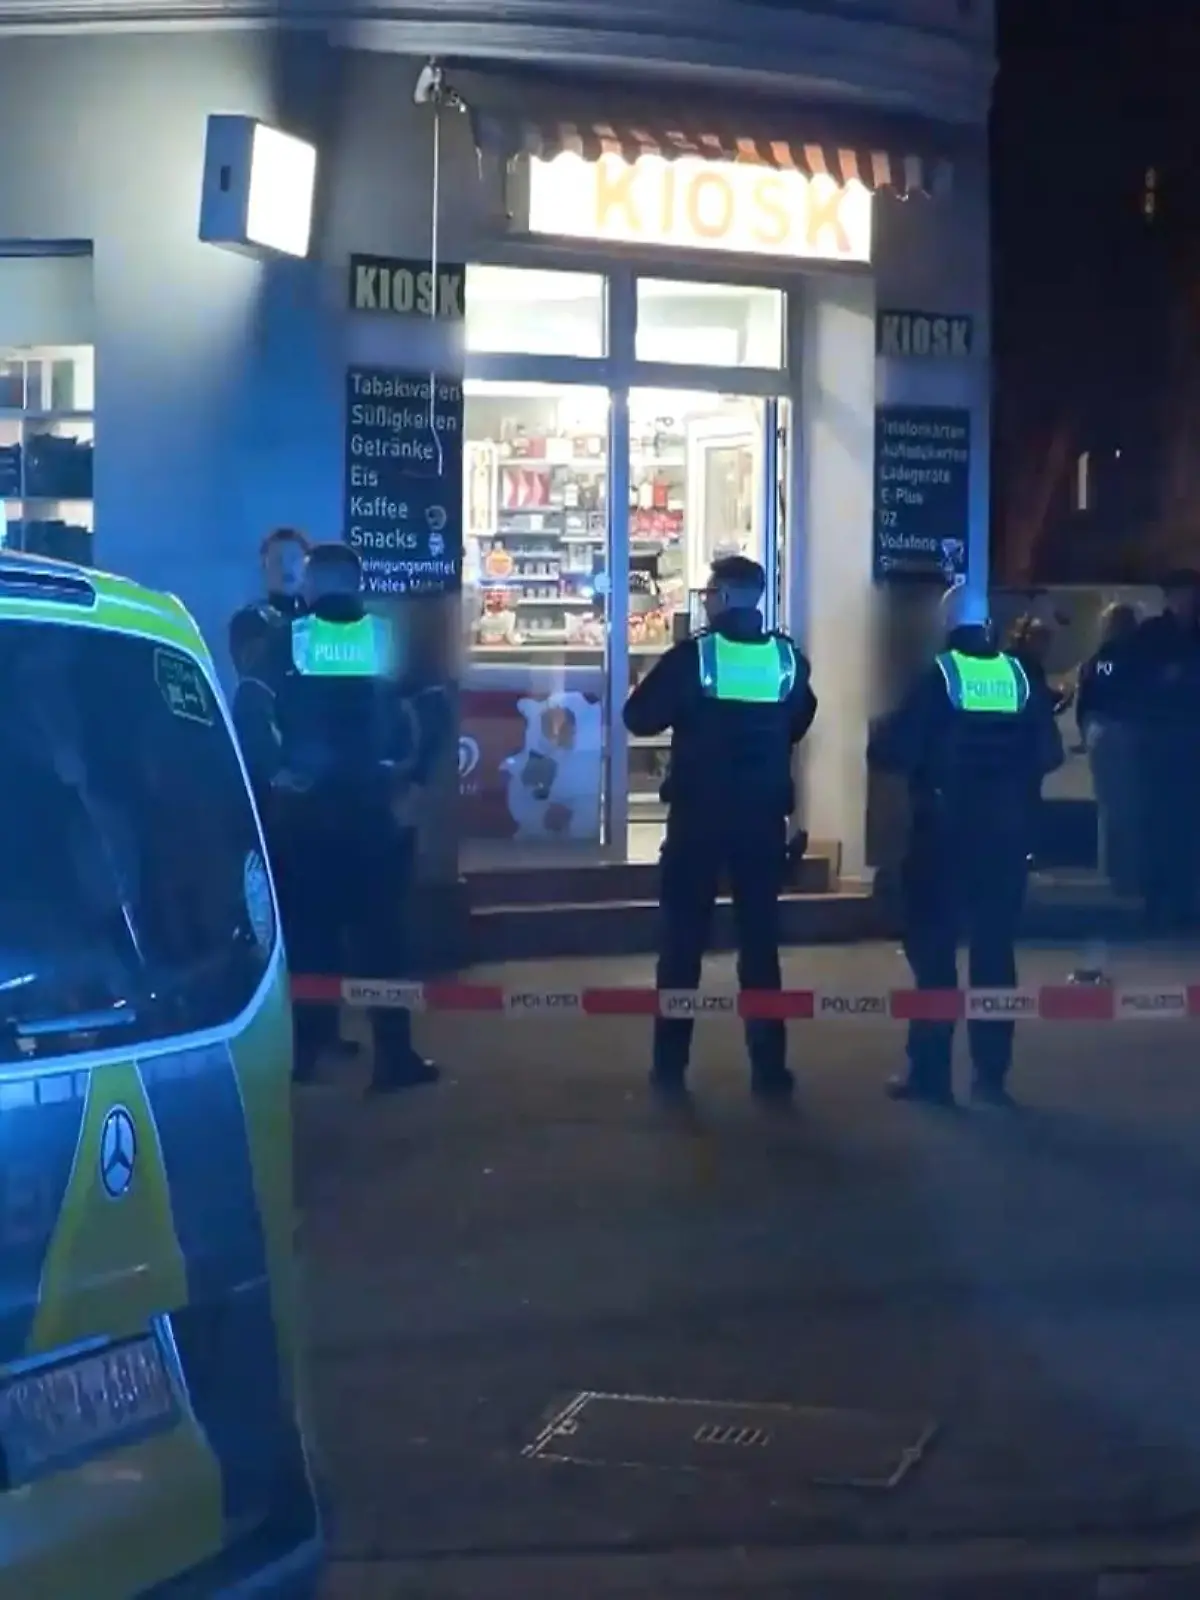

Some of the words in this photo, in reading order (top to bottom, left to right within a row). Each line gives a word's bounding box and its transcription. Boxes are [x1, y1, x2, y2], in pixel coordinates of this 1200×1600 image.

[595, 160, 851, 253] KIOSK
[355, 265, 464, 318] KIOSK
[880, 314, 970, 357] KIOSK
[351, 403, 457, 433] Süßigkeien
[350, 433, 434, 460] Getränke
[350, 464, 379, 487] Eis
[350, 495, 409, 519] Kaffee
[350, 525, 418, 549] Snacks
[361, 558, 457, 577] einigungsmittel
